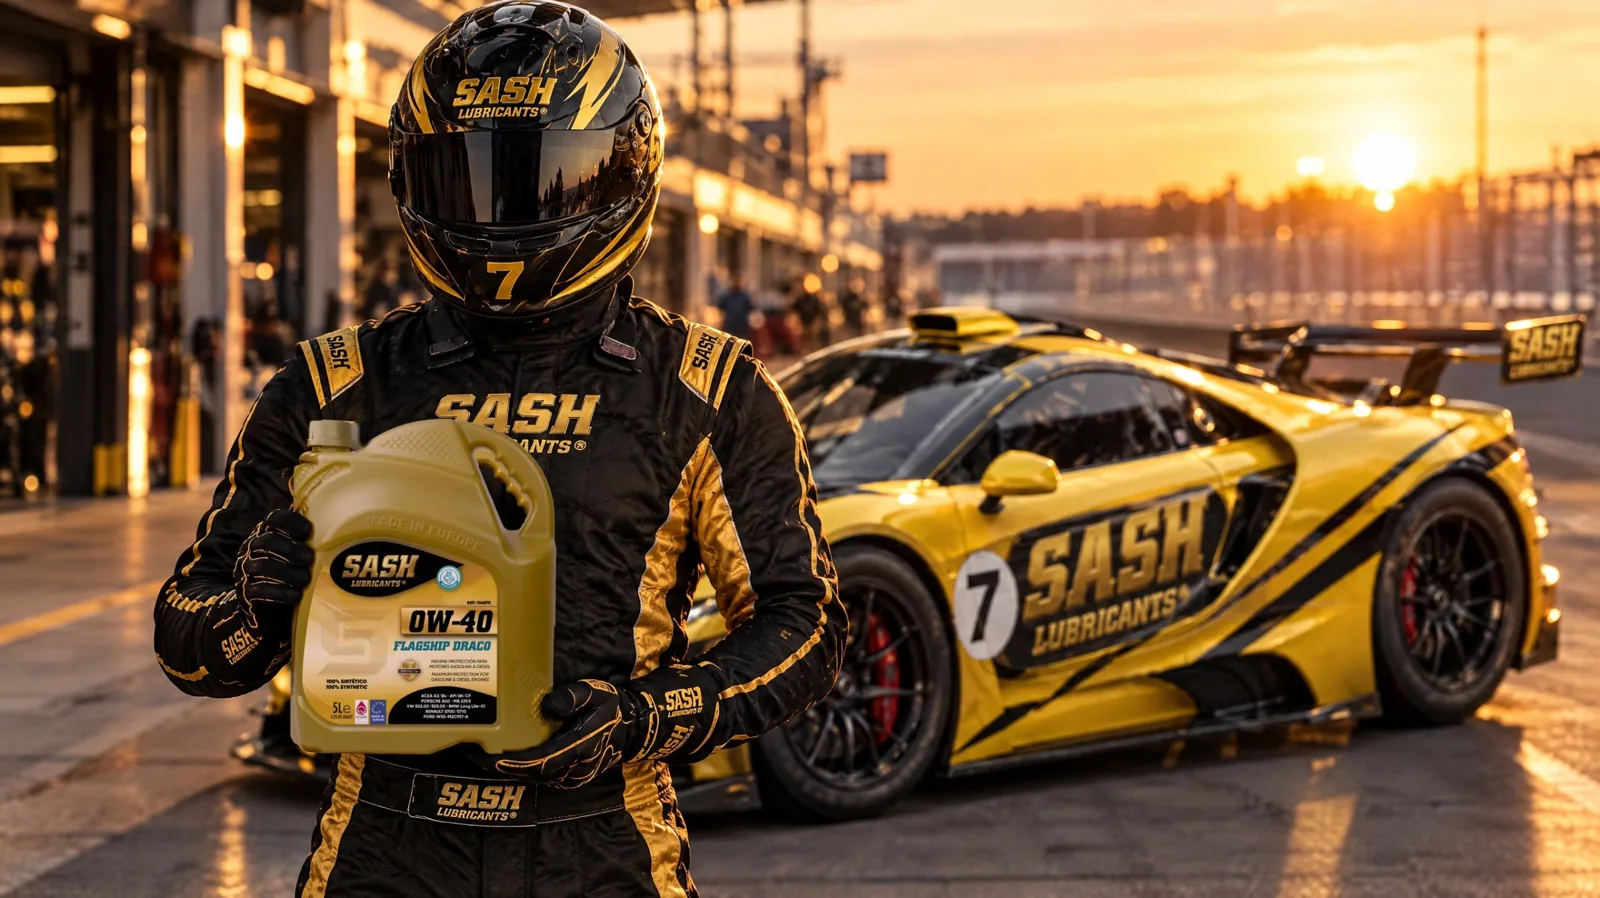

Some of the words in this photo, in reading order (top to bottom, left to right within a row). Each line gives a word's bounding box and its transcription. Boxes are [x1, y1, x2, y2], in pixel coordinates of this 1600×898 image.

[453, 76, 557, 106] SASH
[487, 261, 524, 300] 7
[326, 335, 351, 369] SASH
[691, 332, 719, 370] SASH
[1509, 322, 1580, 364] SASH
[435, 393, 601, 435] SASH
[342, 554, 420, 578] SASH
[1023, 493, 1208, 623] SASH
[408, 610, 494, 633] 0W-40
[966, 570, 1000, 643] 7
[393, 641, 451, 651] FLAGSHIP
[452, 641, 492, 651] DRACO
[664, 686, 704, 712] SASH
[438, 782, 525, 811] SASH
